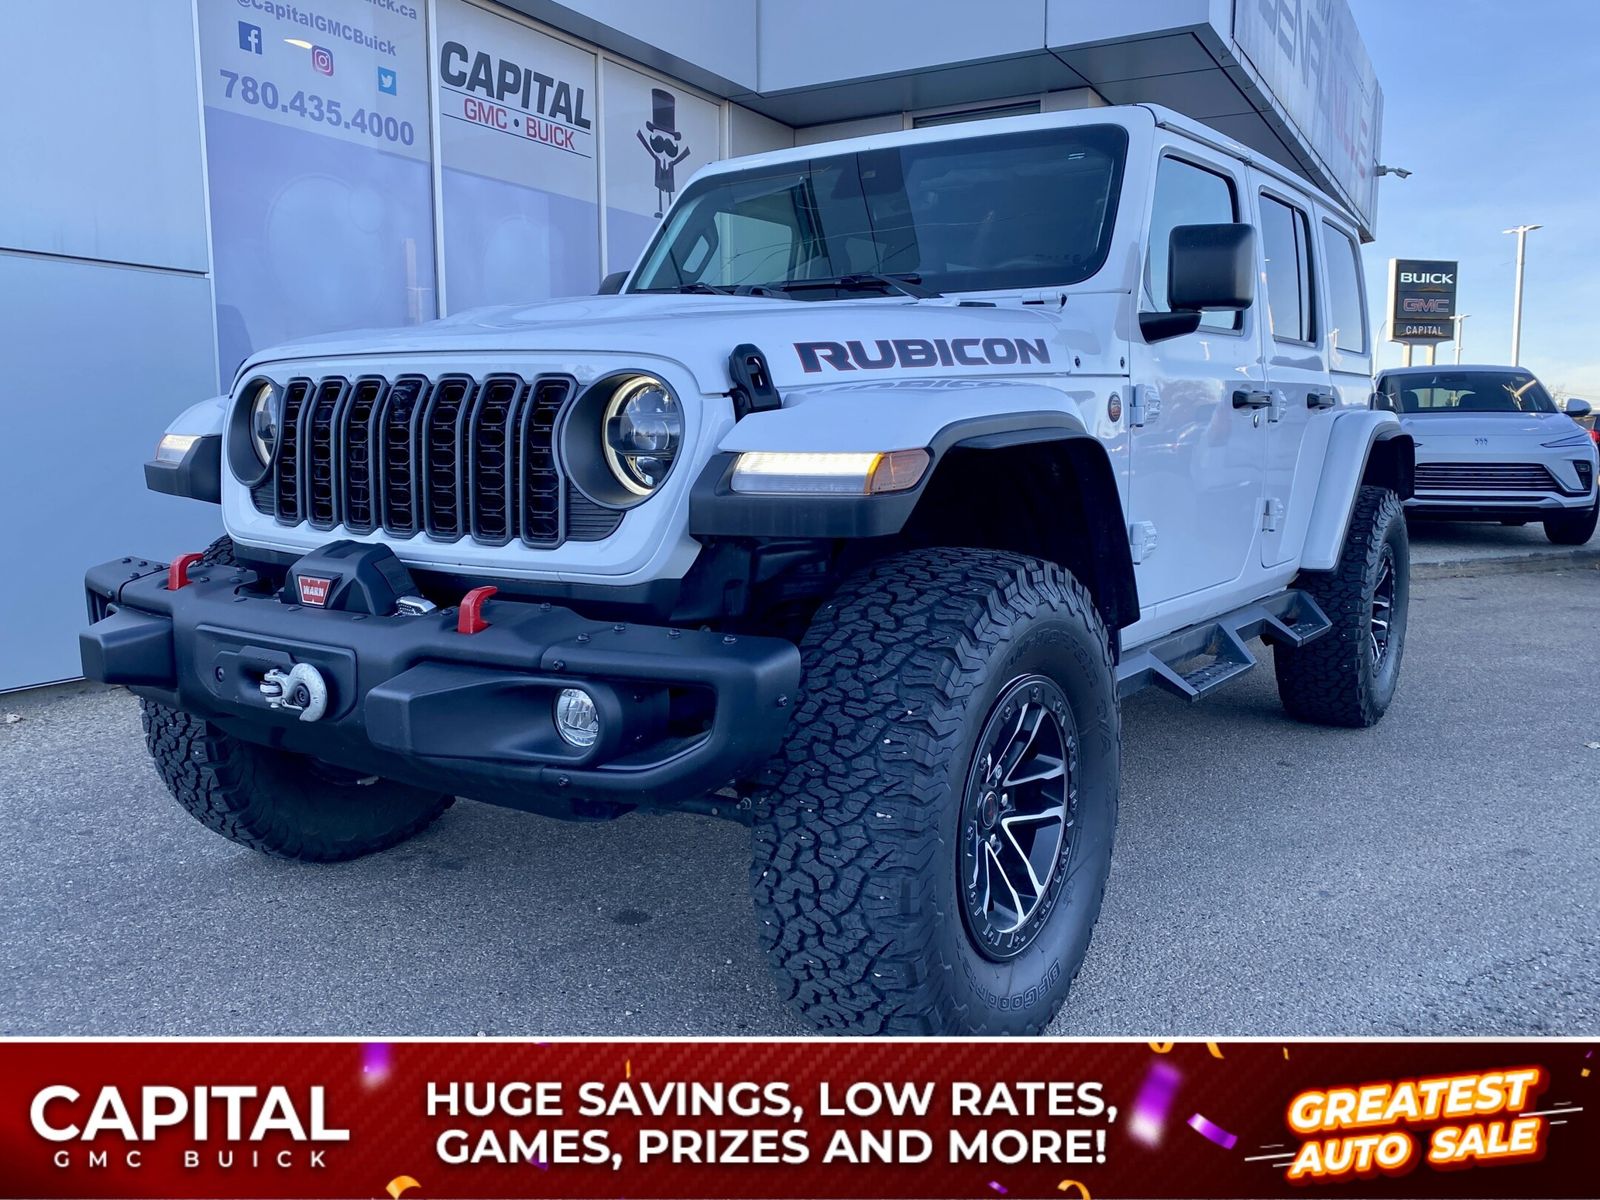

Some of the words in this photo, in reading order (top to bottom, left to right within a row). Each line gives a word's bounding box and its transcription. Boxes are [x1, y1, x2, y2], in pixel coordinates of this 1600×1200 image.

[440, 41, 591, 130] CAPITAL
[219, 69, 414, 146] 780.435.4000
[464, 98, 508, 130] GMC
[526, 116, 575, 150] BUICK
[1400, 272, 1454, 284] BUICK
[1403, 298, 1450, 313] GMC
[1405, 325, 1443, 335] CAPITAL
[793, 338, 1051, 373] RUBICON
[303, 585, 325, 597] WARN
